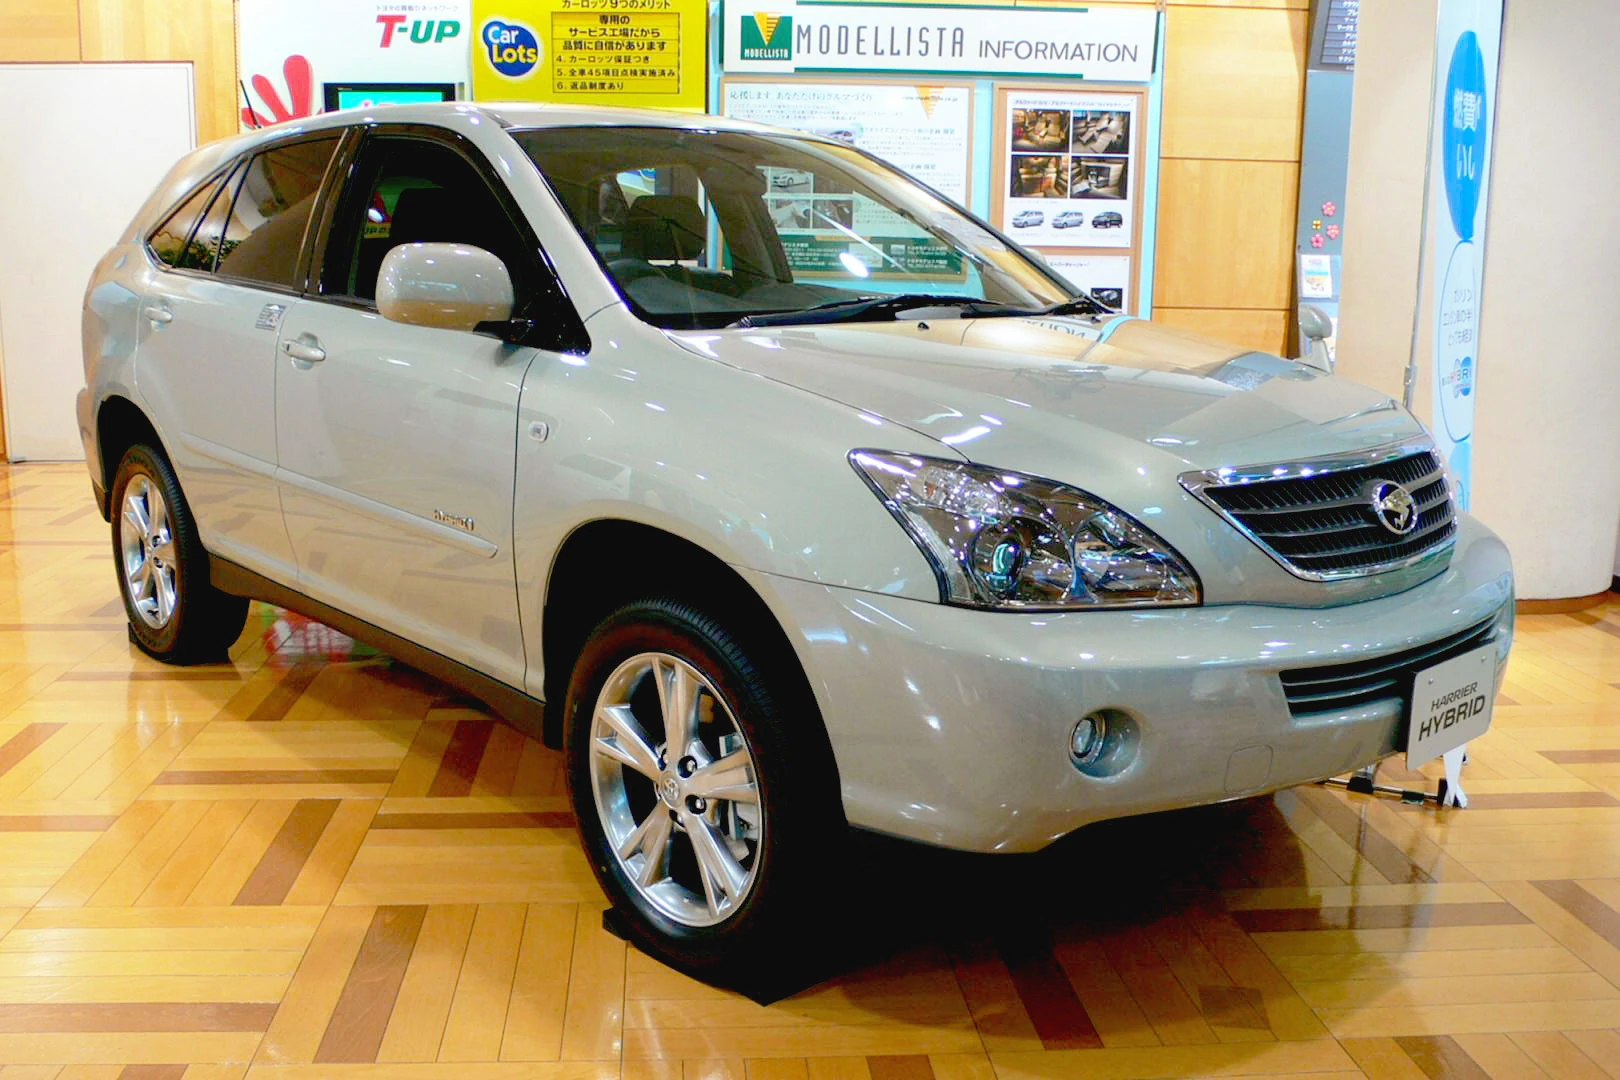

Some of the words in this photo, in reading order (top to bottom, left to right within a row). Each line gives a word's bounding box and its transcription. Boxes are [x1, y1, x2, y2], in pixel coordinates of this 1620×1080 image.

[599, 15, 630, 25] 専用の
[376, 14, 461, 48] T-UP
[488, 26, 520, 45] Car
[569, 28, 661, 38] サービス工場だから
[562, 41, 667, 51] 品質に自信があります
[796, 24, 965, 58] MODELLISTA
[978, 40, 1139, 63] INFORMATION
[492, 44, 538, 64] Lots
[744, 48, 789, 59] MODELLISTA
[1431, 681, 1478, 712] HARRIER
[1418, 694, 1486, 742] HYBRID
